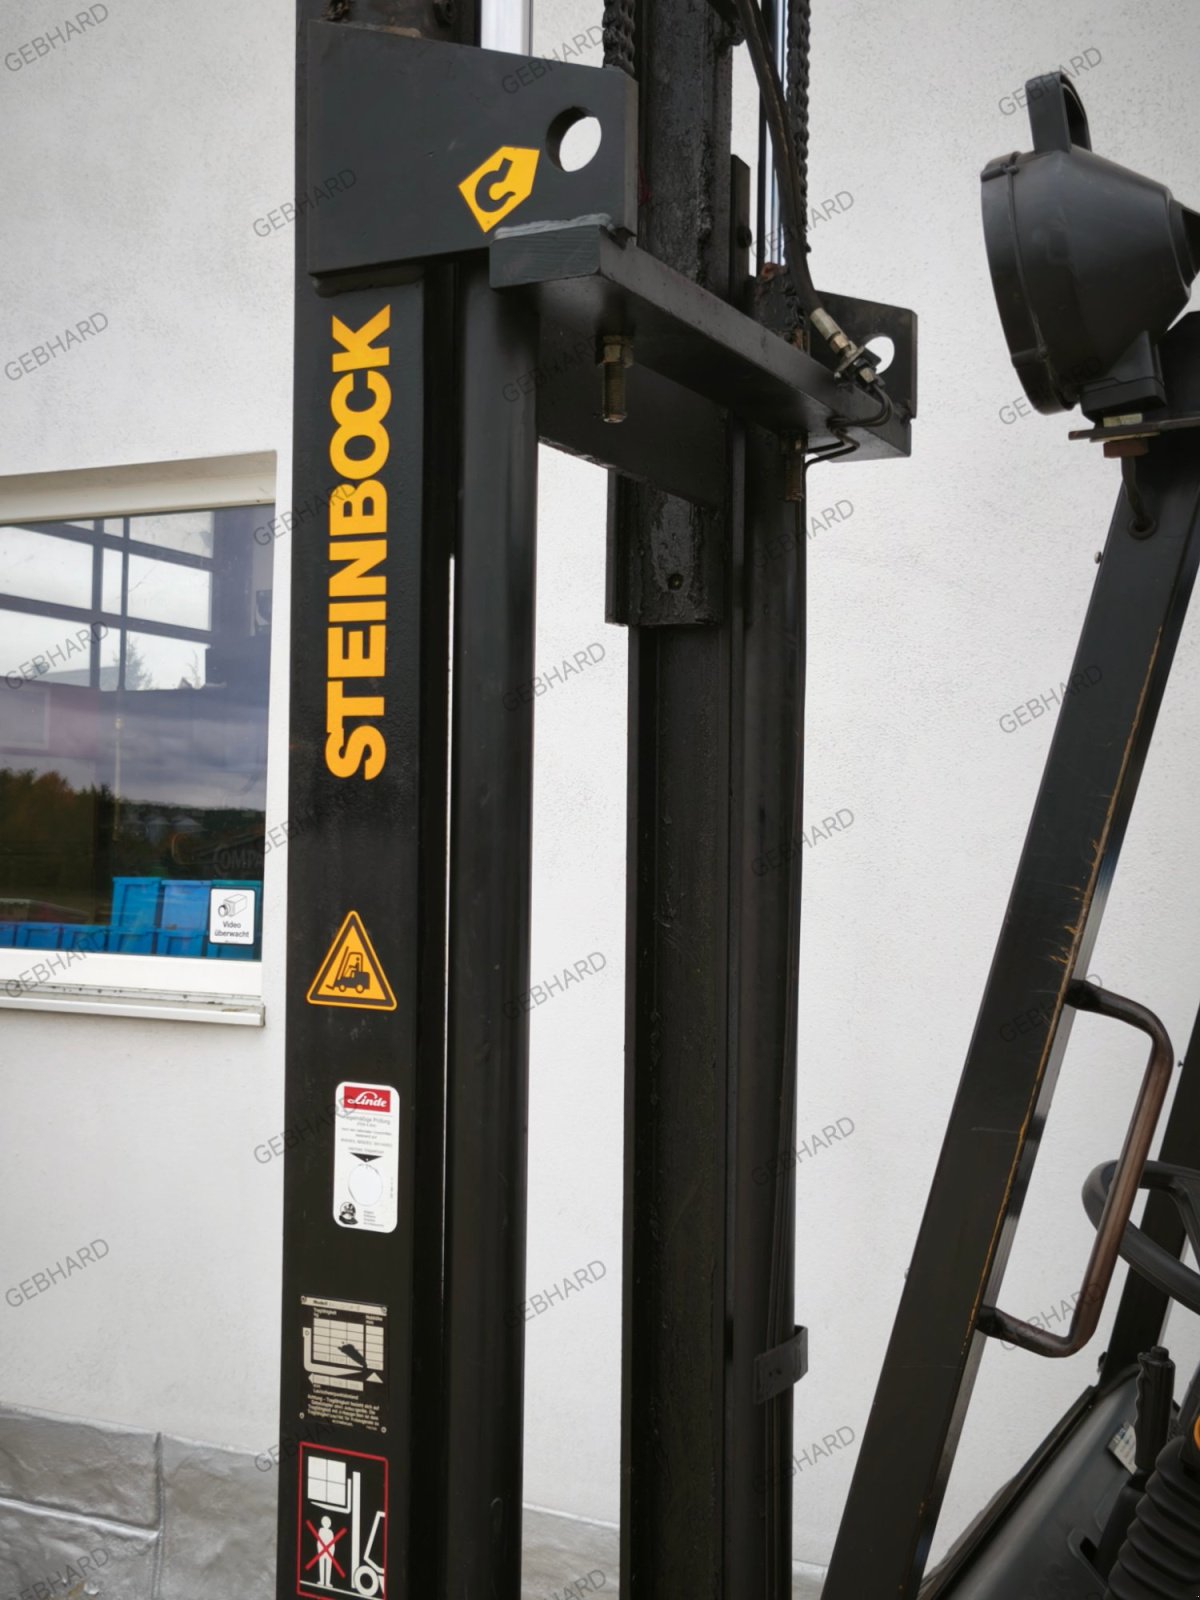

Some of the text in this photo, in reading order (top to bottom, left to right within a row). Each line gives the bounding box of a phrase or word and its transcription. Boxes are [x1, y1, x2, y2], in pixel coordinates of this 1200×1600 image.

[325, 304, 392, 780] STEINBOCK
[223, 920, 242, 929] Video
[214, 929, 249, 938] überwacht
[347, 1091, 387, 1107] Linde
